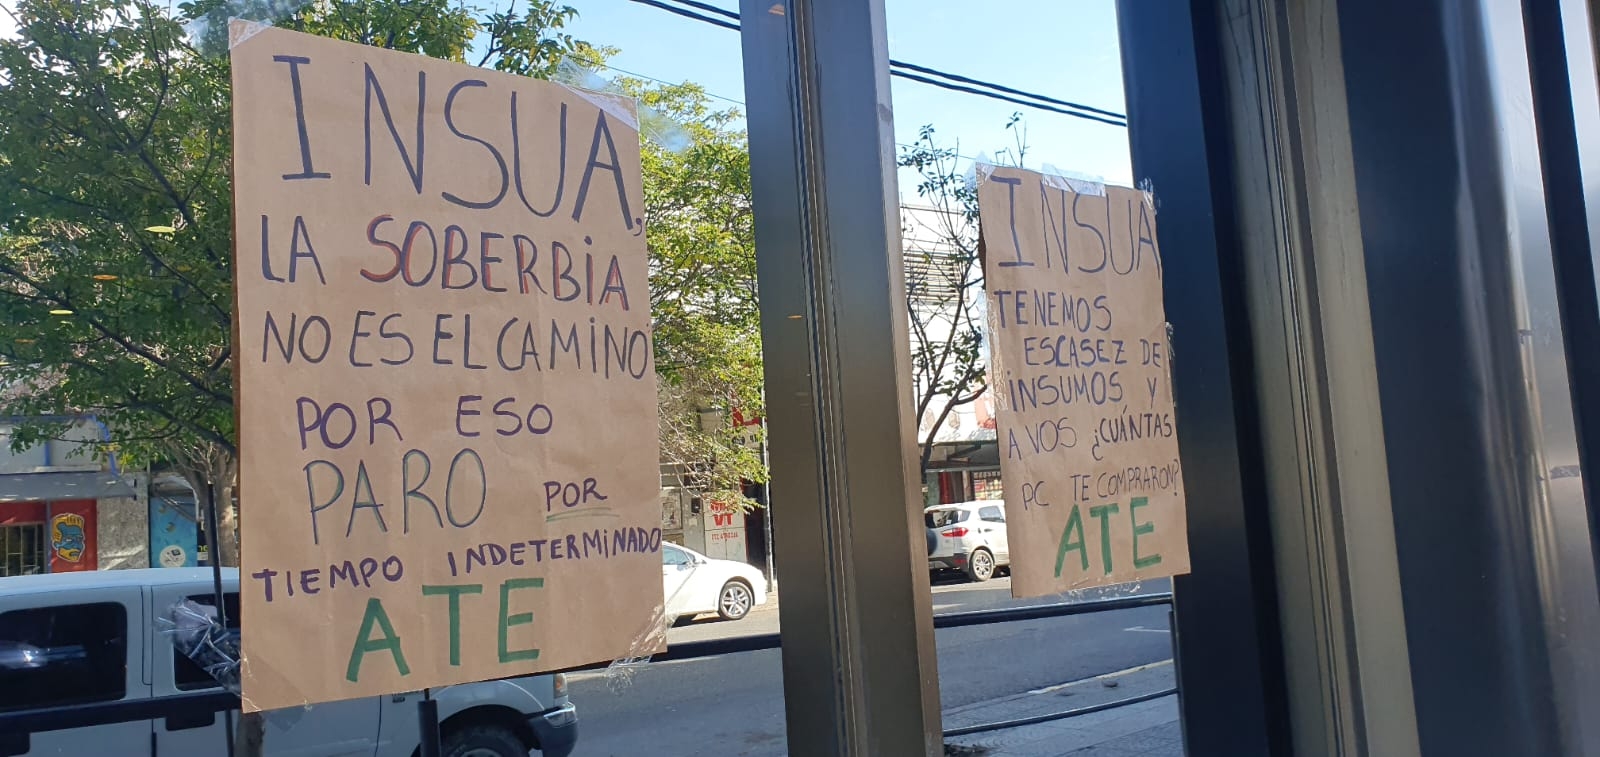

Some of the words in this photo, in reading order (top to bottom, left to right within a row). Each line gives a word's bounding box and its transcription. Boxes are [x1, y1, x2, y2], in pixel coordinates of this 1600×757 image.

[273, 55, 642, 236] INSUA,
[261, 214, 326, 285] LA
[990, 175, 1161, 280] INSUA
[262, 310, 331, 364] NO
[349, 310, 414, 367] ES
[432, 313, 488, 370] EL
[993, 289, 1112, 333] TENEMOS
[1024, 335, 1128, 368] ESCASEZ
[1140, 338, 1161, 367] DE
[1147, 377, 1157, 408] Y
[296, 396, 403, 450] POR
[455, 395, 553, 437] ESO
[1008, 428, 1022, 460] A
[1025, 417, 1078, 454] VOS
[1092, 405, 1173, 461] ¿CUÁNTAS
[303, 448, 487, 545] PARO
[543, 477, 608, 512] POR
[1022, 481, 1049, 510] PC
[1070, 474, 1091, 502] TE
[1096, 459, 1180, 498] COMPRARON?
[1054, 496, 1162, 578] ATE
[252, 555, 404, 602] TIEMPO
[346, 577, 545, 682] ATE
